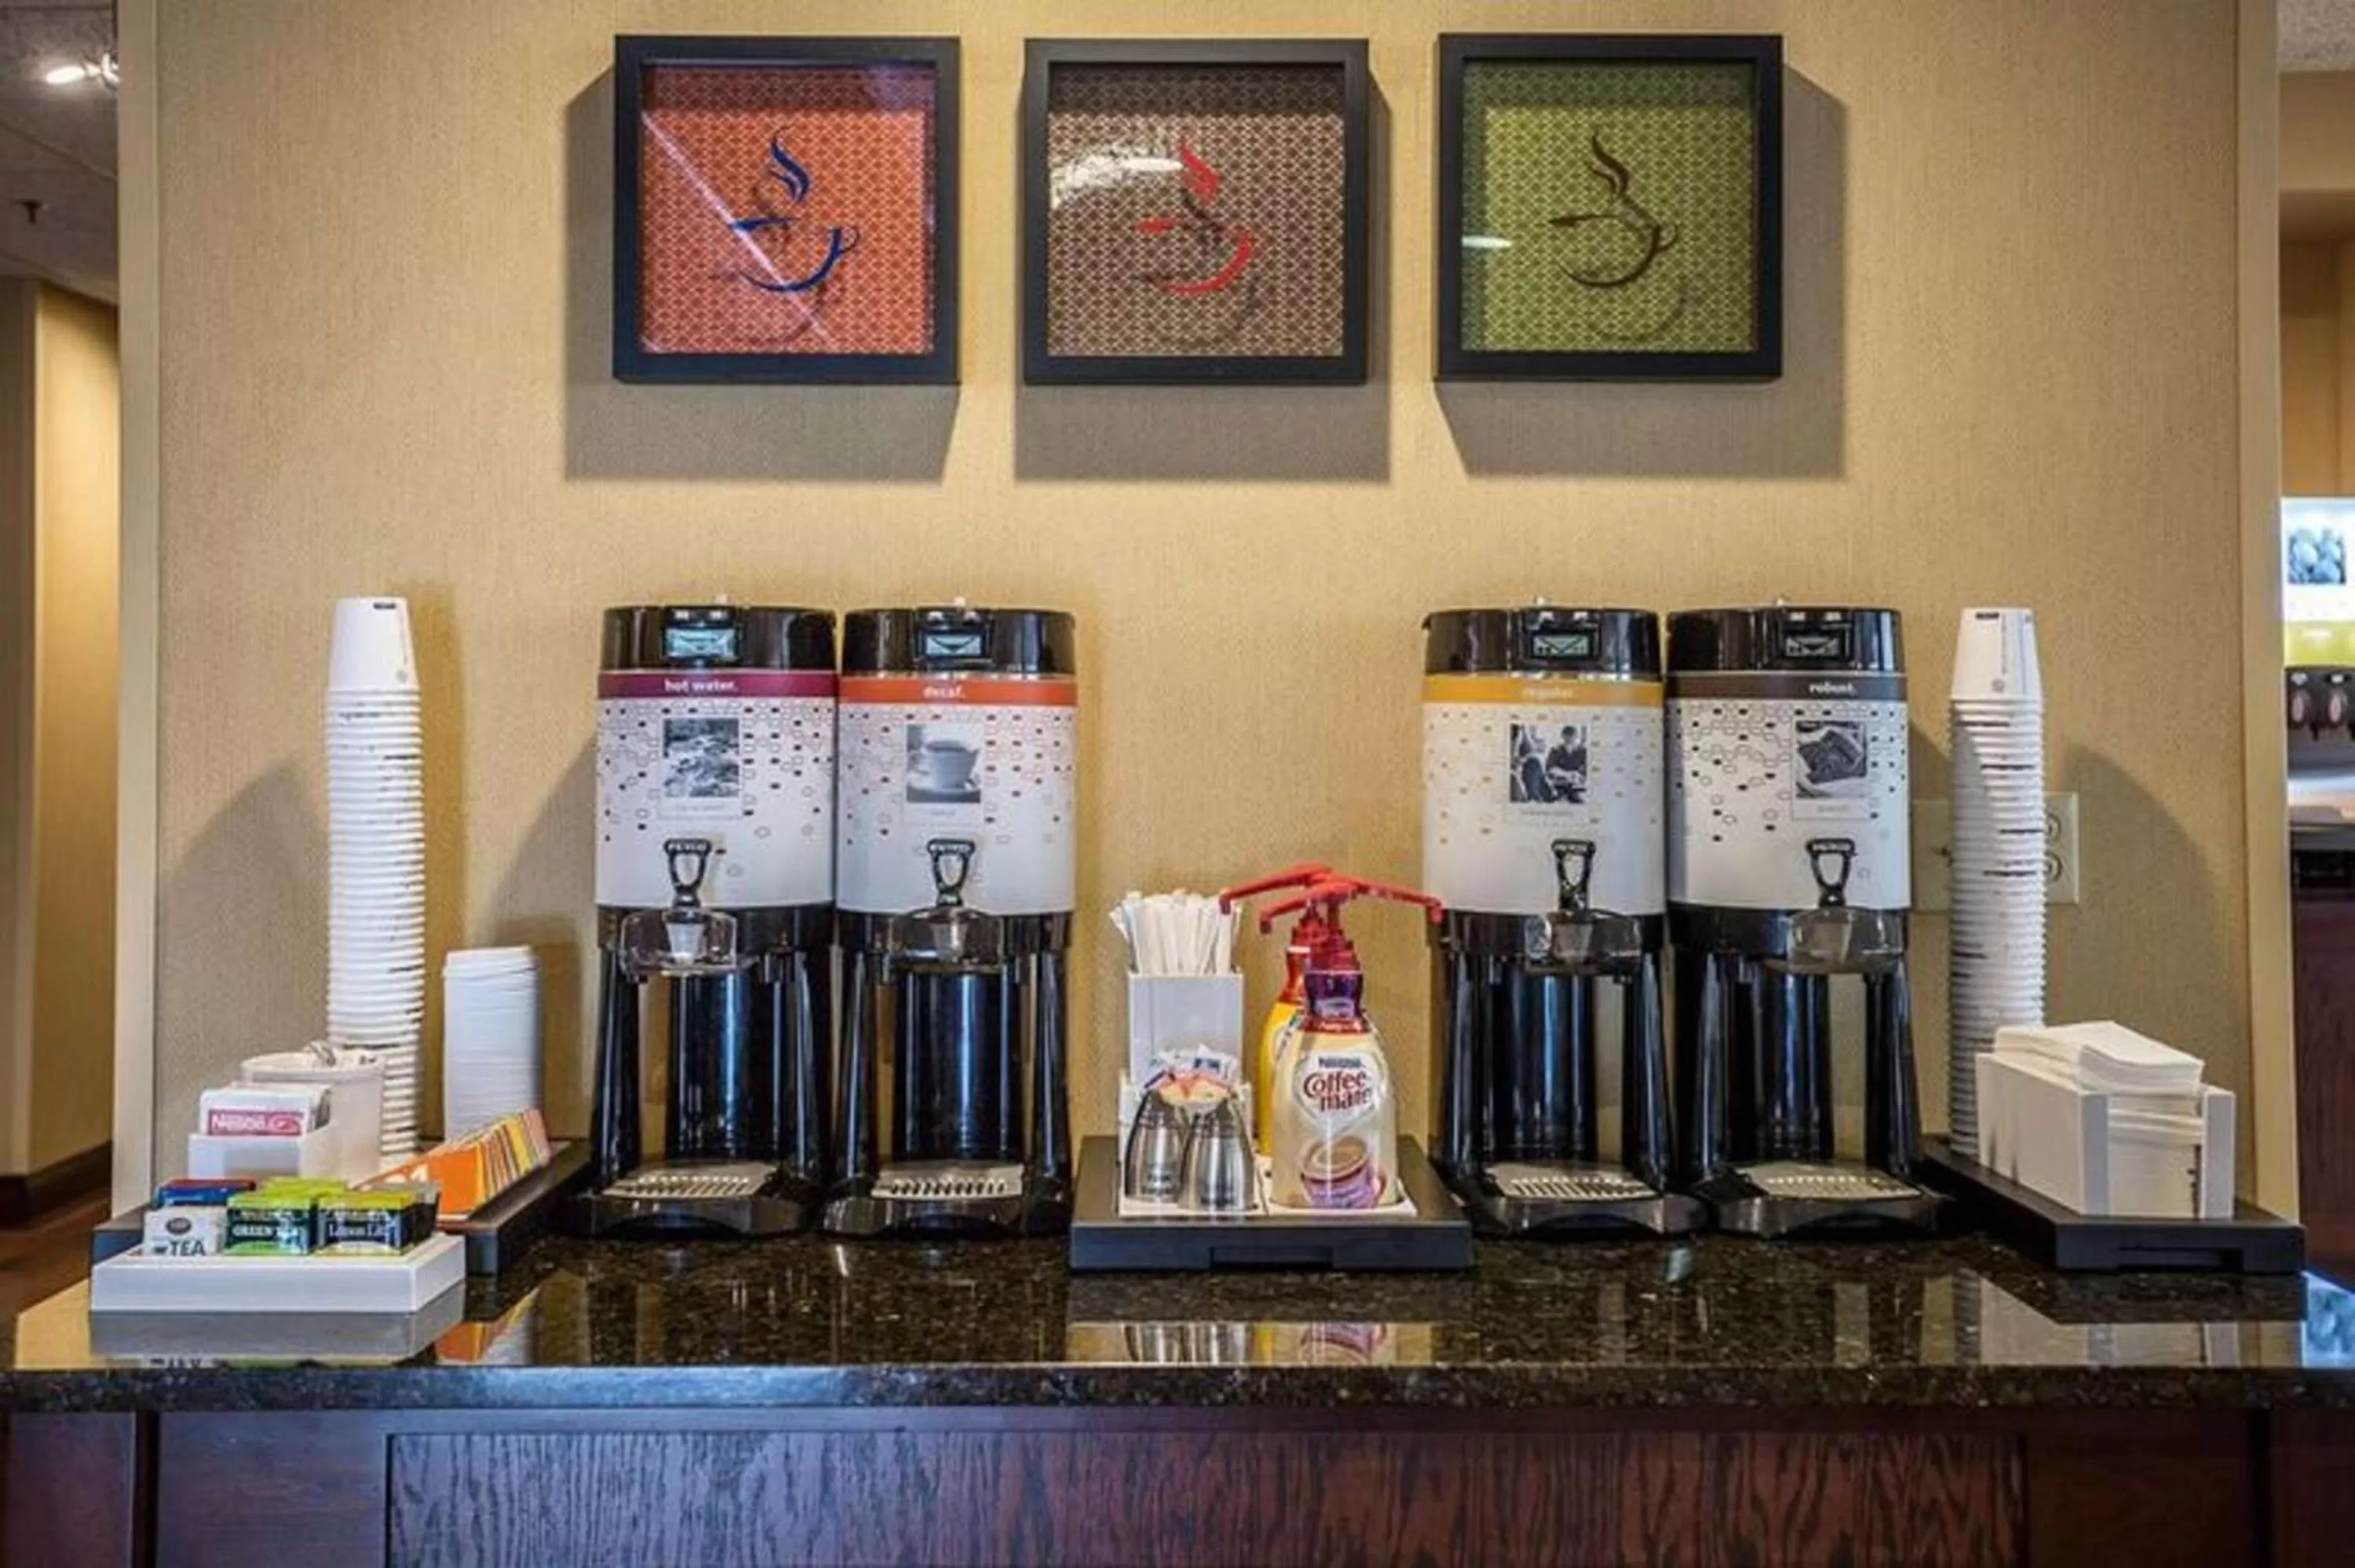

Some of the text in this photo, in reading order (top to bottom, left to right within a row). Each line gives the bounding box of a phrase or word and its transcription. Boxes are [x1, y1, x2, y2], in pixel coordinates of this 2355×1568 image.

[664, 677, 689, 694] hot
[1303, 1070, 1368, 1099] Coffee
[1320, 1088, 1372, 1112] mate
[232, 1223, 273, 1238] GREEN
[168, 1239, 206, 1257] TEA
